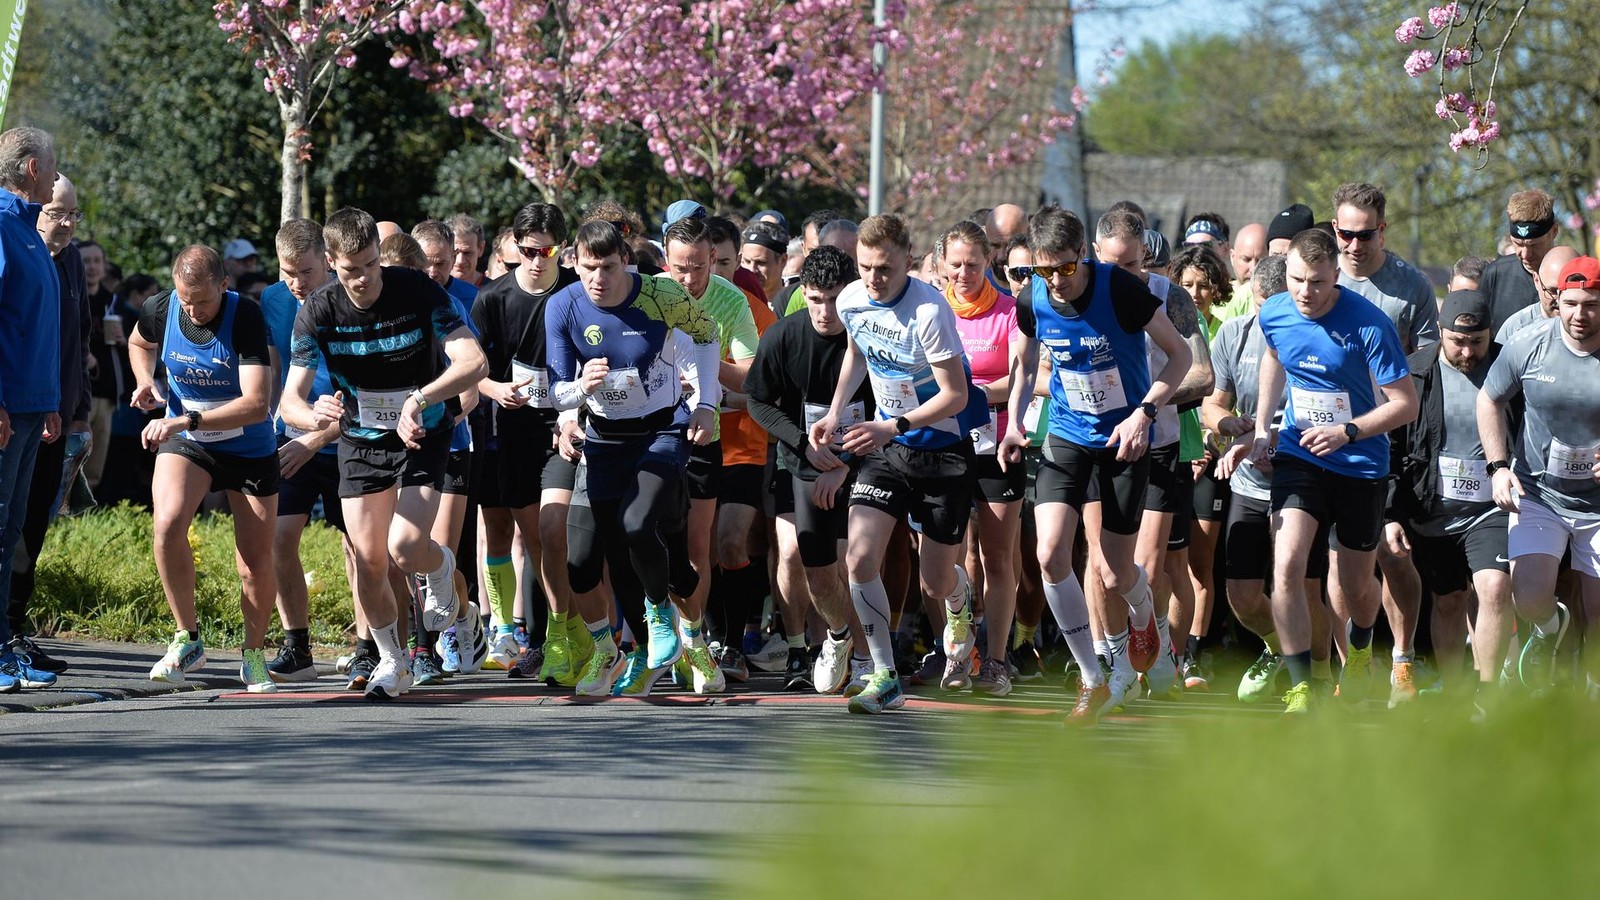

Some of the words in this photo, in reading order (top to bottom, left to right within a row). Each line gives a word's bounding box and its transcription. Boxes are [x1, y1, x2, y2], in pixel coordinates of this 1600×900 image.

[872, 321, 902, 341] bunert
[328, 342, 354, 354] RUN
[357, 328, 421, 354] ACADEMY
[867, 345, 899, 365] ASV
[185, 367, 214, 379] ASV
[1535, 374, 1556, 383] JAKO
[173, 374, 231, 387] DUISBURG
[527, 387, 548, 398] 888
[600, 390, 628, 401] 1858
[1079, 390, 1107, 404] 1412
[1306, 411, 1335, 423] 1393
[1564, 462, 1594, 472] 1800
[852, 481, 893, 500] bunert
[1451, 478, 1481, 491] 1788
